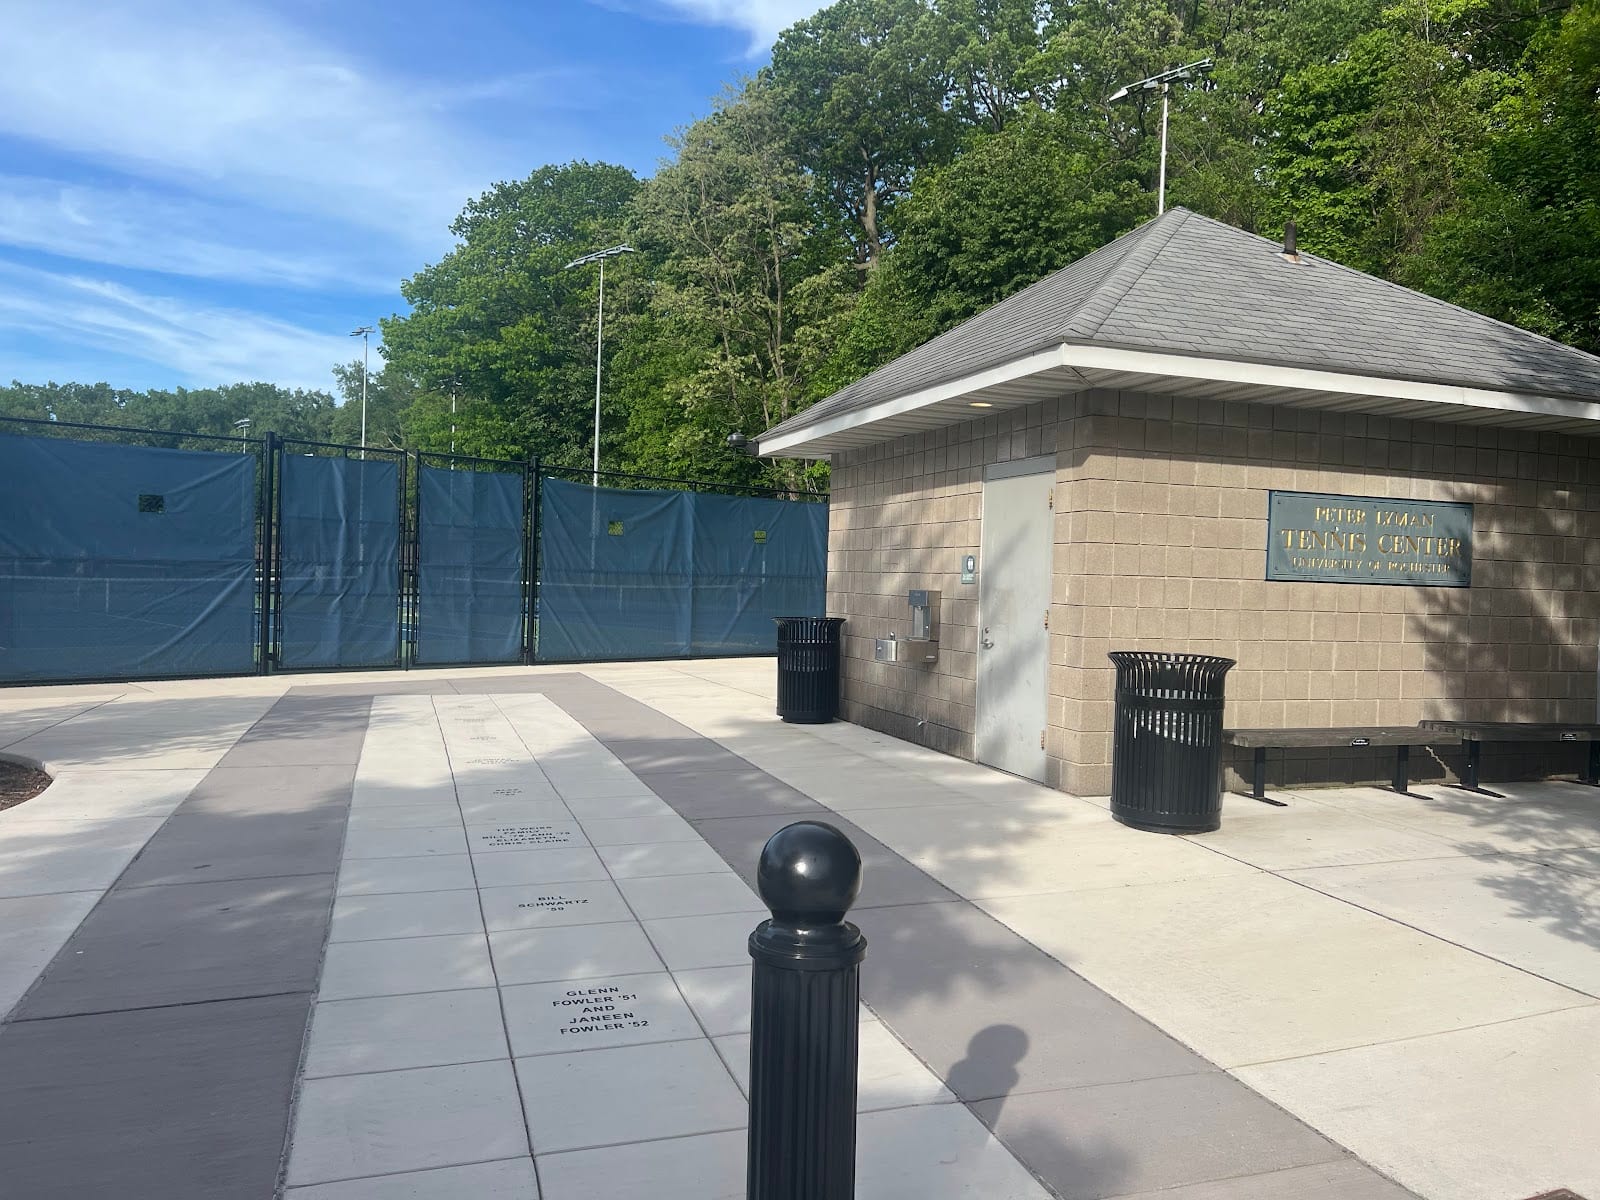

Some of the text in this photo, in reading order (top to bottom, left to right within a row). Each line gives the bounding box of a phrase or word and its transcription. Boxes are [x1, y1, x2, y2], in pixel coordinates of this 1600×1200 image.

[1315, 506, 1436, 529] PETER LYMAN
[1281, 528, 1462, 557] TENNIS CENTER
[1292, 557, 1451, 575] UNIVERSITY OF ROCHESTER
[517, 899, 589, 908] SCHWARTZ
[566, 987, 619, 997] GLENN
[552, 996, 614, 1007] FOWLER
[582, 1005, 615, 1013] AND
[569, 1012, 635, 1024] JANEEN
[560, 1020, 649, 1035] FOWLER '52
